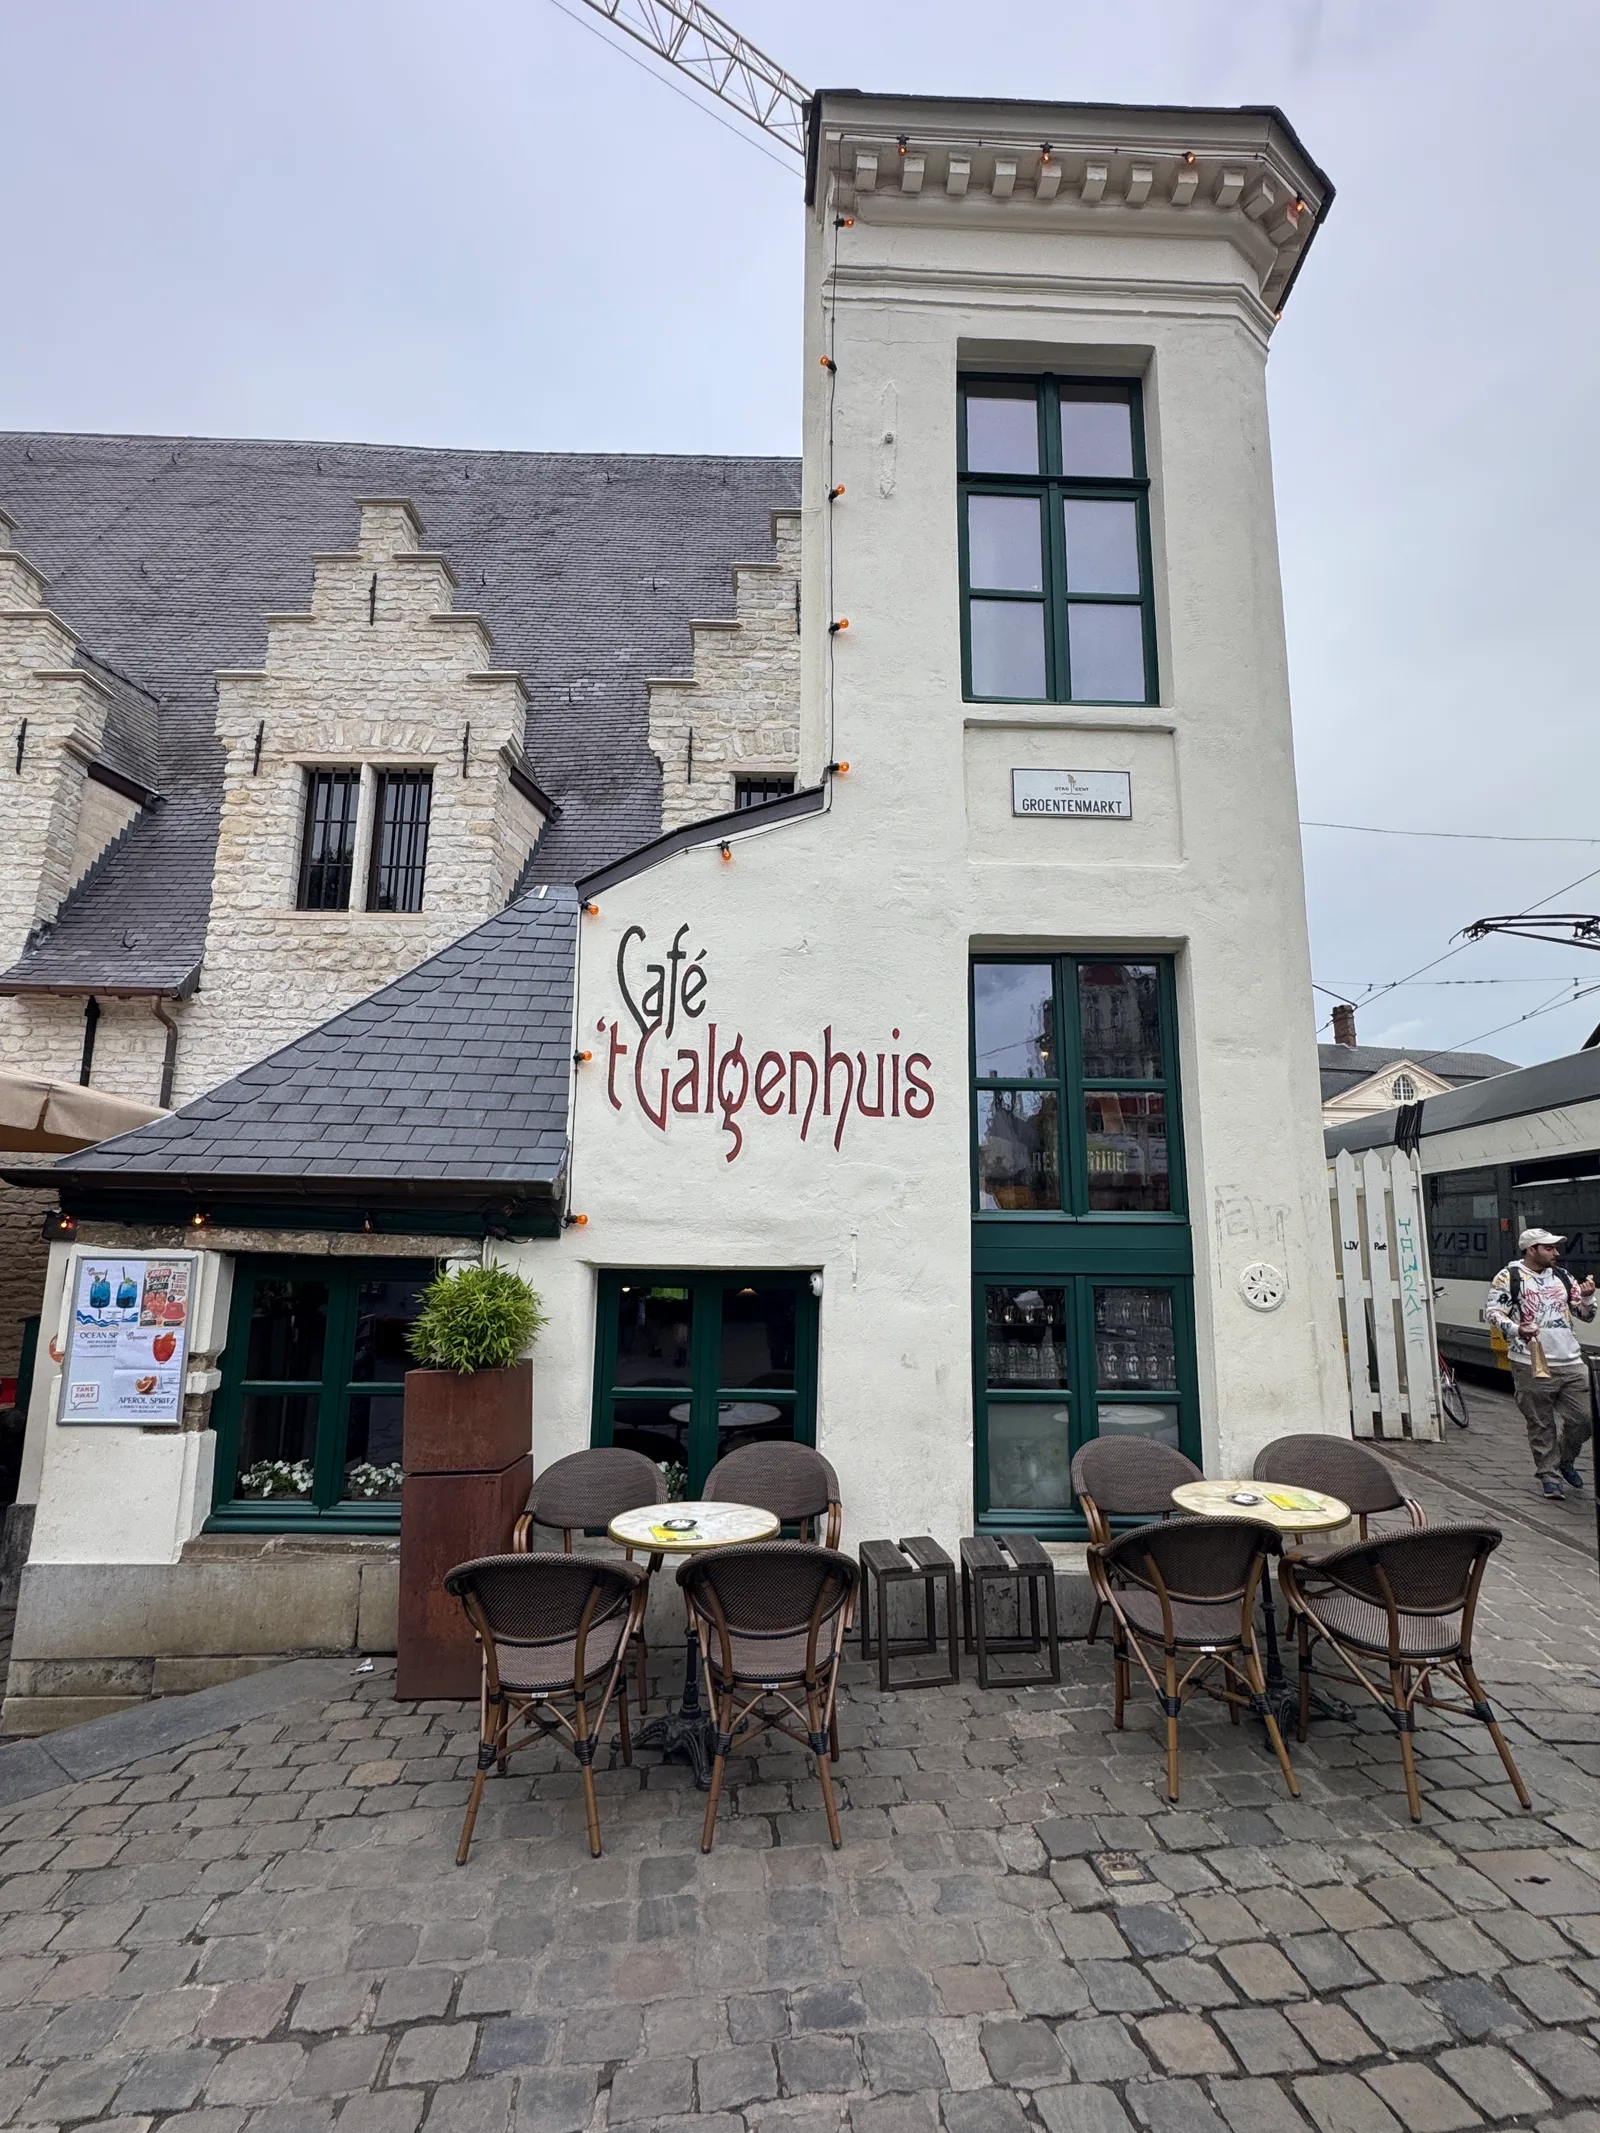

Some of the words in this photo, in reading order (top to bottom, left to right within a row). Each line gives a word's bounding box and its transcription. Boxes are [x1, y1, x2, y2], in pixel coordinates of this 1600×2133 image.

[1022, 798, 1122, 814] GROENTENMARKT
[617, 922, 708, 1039] Café
[634, 1017, 935, 1163] Galgenhuis
